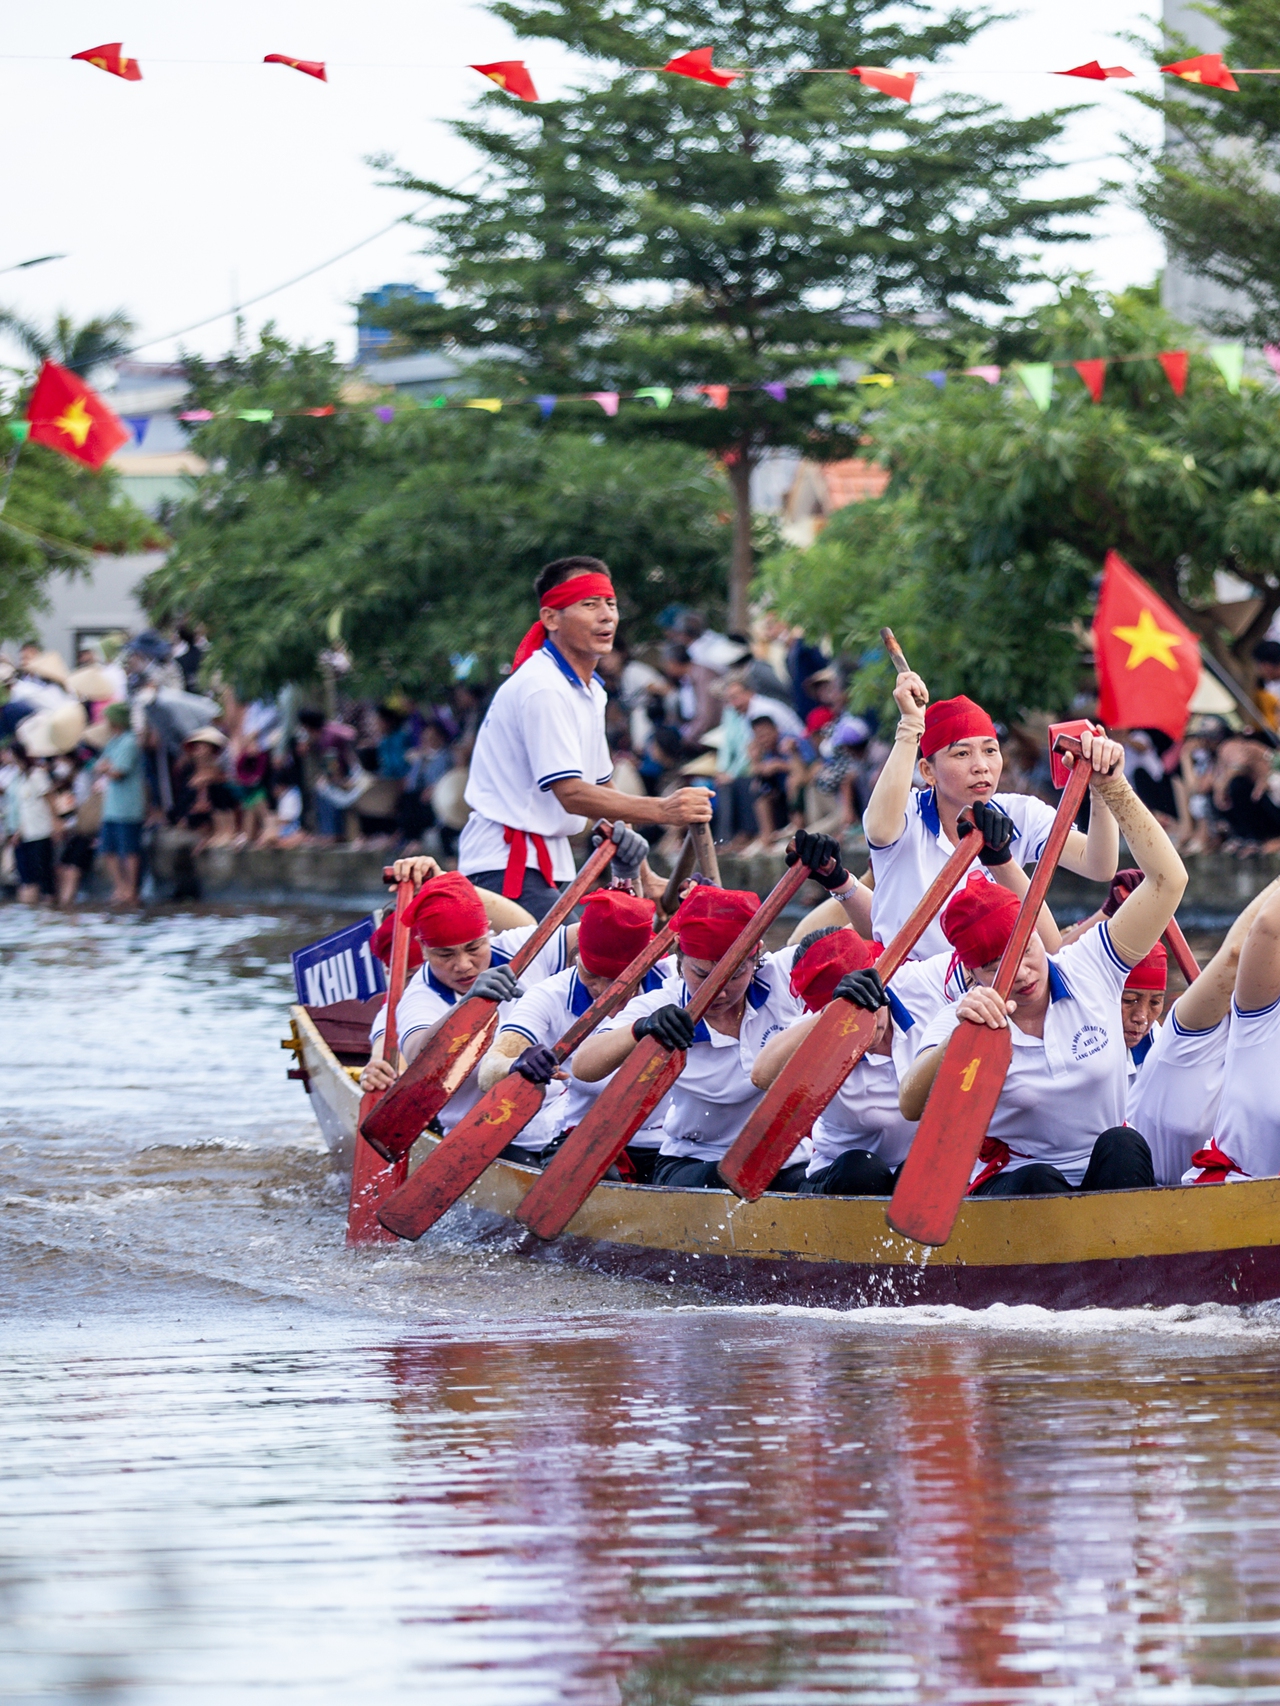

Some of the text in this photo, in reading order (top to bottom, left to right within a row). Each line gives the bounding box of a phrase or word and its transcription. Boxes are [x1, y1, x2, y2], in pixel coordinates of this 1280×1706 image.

[304, 940, 377, 1008] KHU 1
[959, 1057, 982, 1091] 1
[484, 1098, 519, 1125] 3
